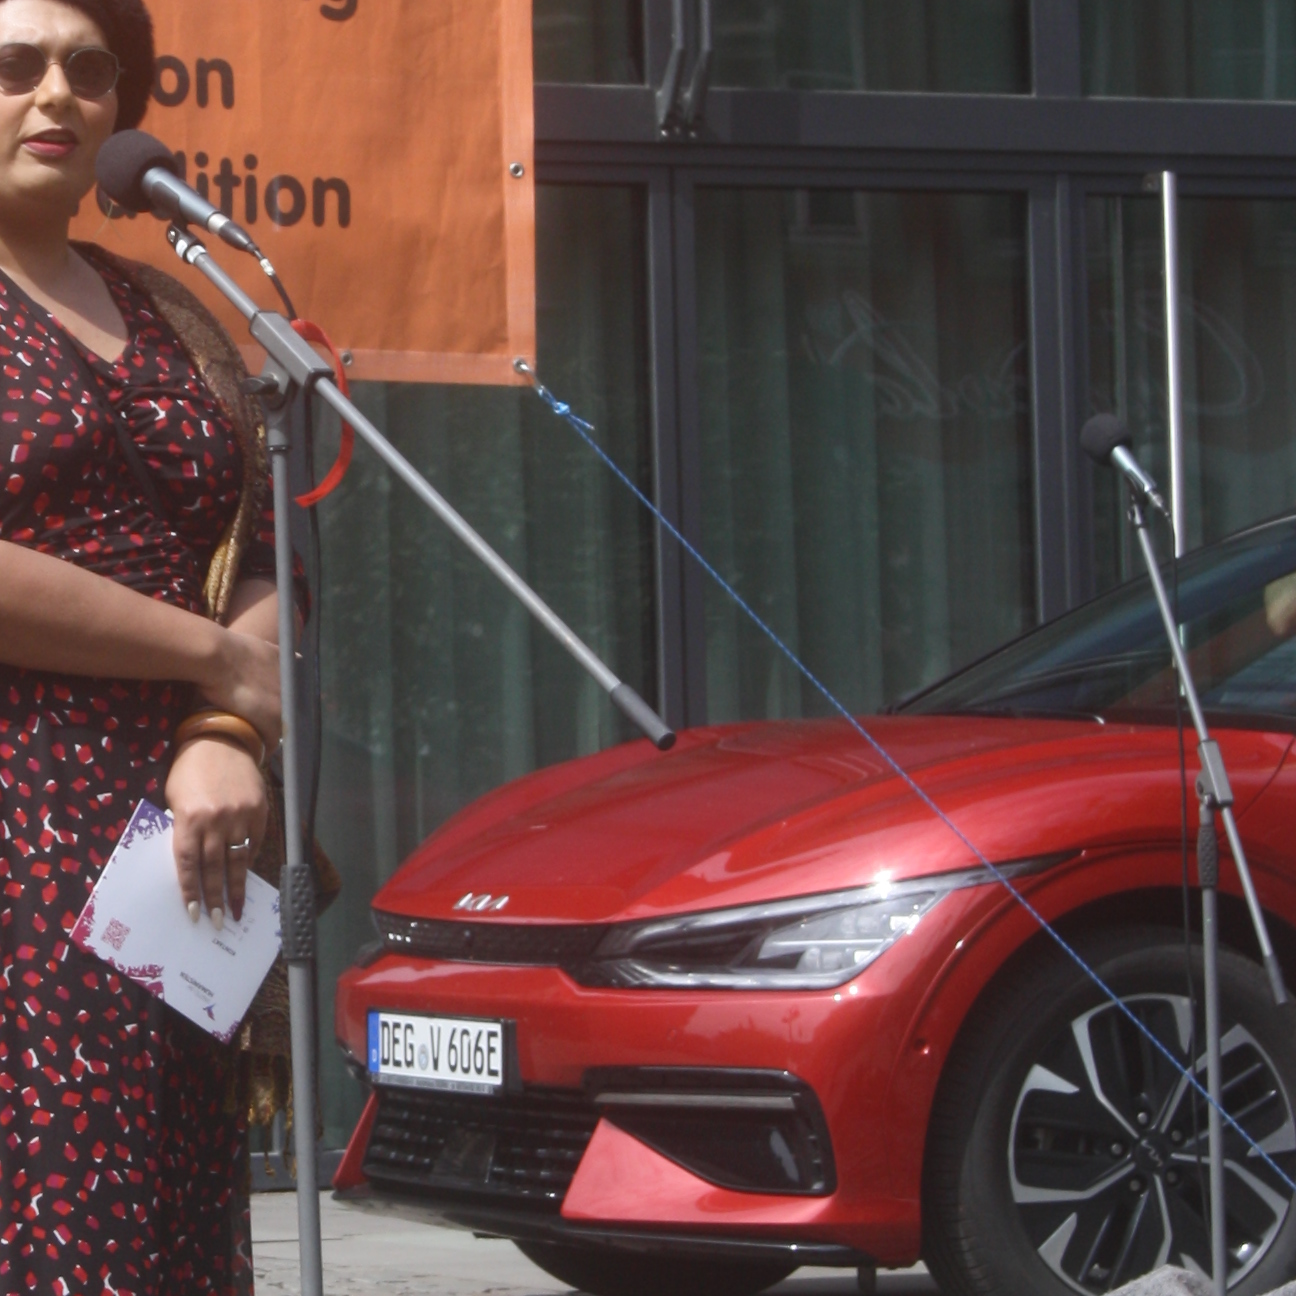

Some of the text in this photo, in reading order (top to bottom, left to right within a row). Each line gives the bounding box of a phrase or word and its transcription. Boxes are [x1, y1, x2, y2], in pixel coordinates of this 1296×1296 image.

[149, 53, 236, 110] on
[453, 892, 510, 912] KIA
[380, 1020, 500, 1078] DEG V 606E
